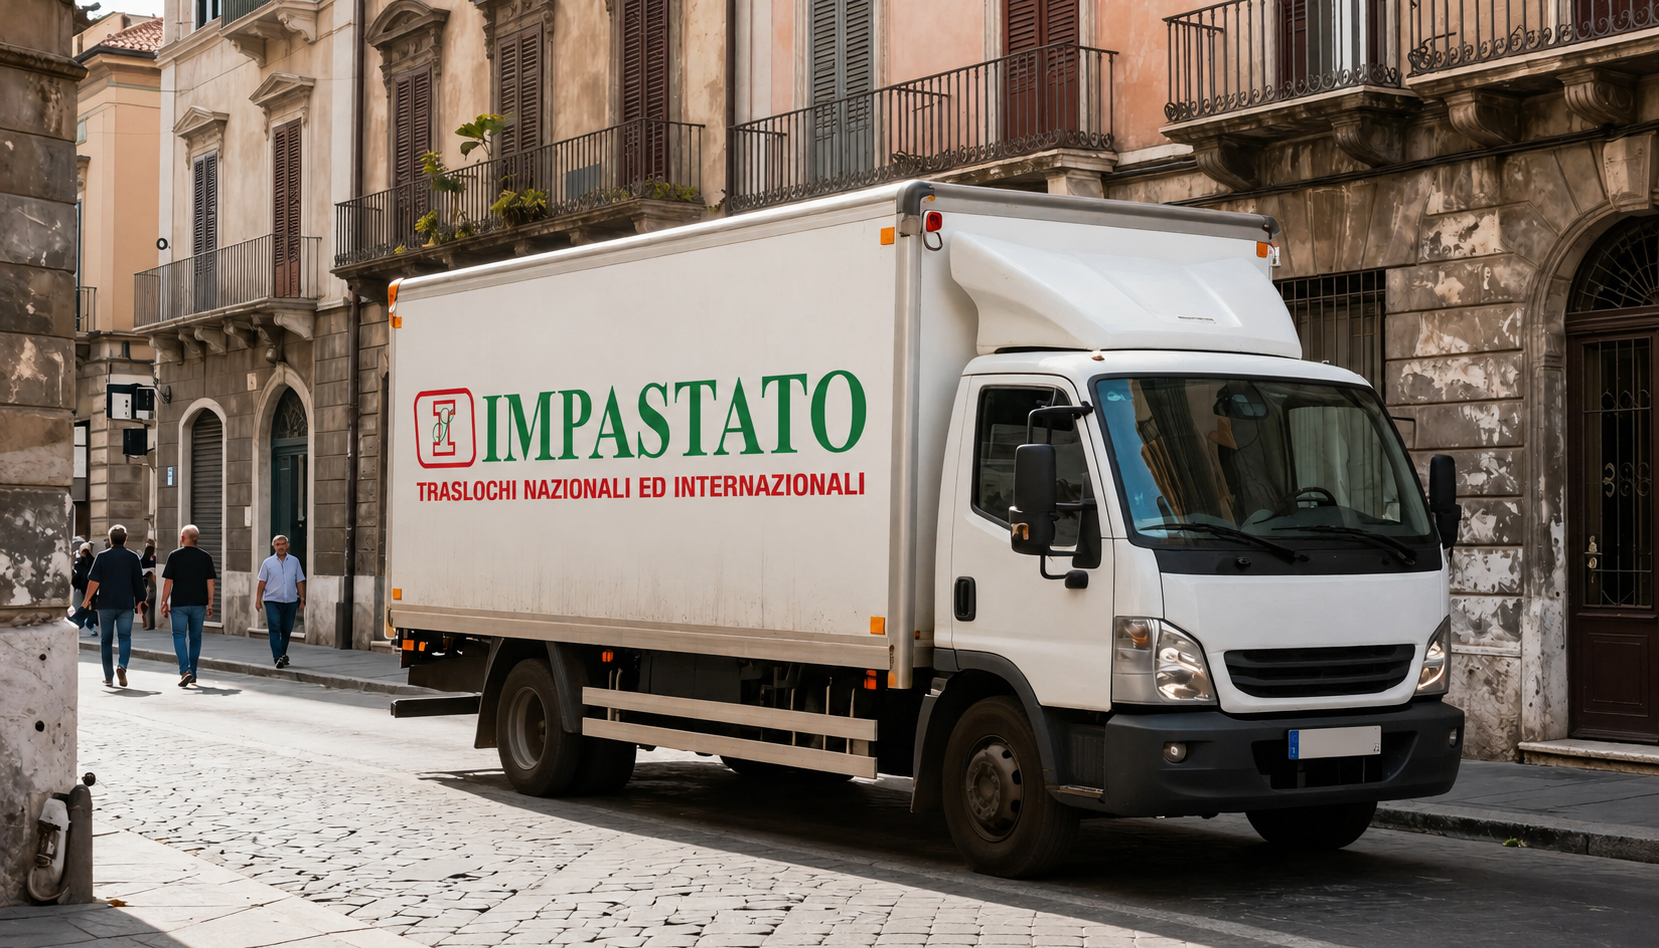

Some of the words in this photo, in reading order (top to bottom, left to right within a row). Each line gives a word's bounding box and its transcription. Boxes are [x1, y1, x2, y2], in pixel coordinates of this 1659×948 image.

[482, 369, 867, 462] IMPASTATO
[416, 480, 517, 502] TRASLOCHI
[523, 478, 631, 500] NAZIONALI
[638, 477, 667, 499] ED
[674, 472, 866, 498] INTERNAZIONALI
